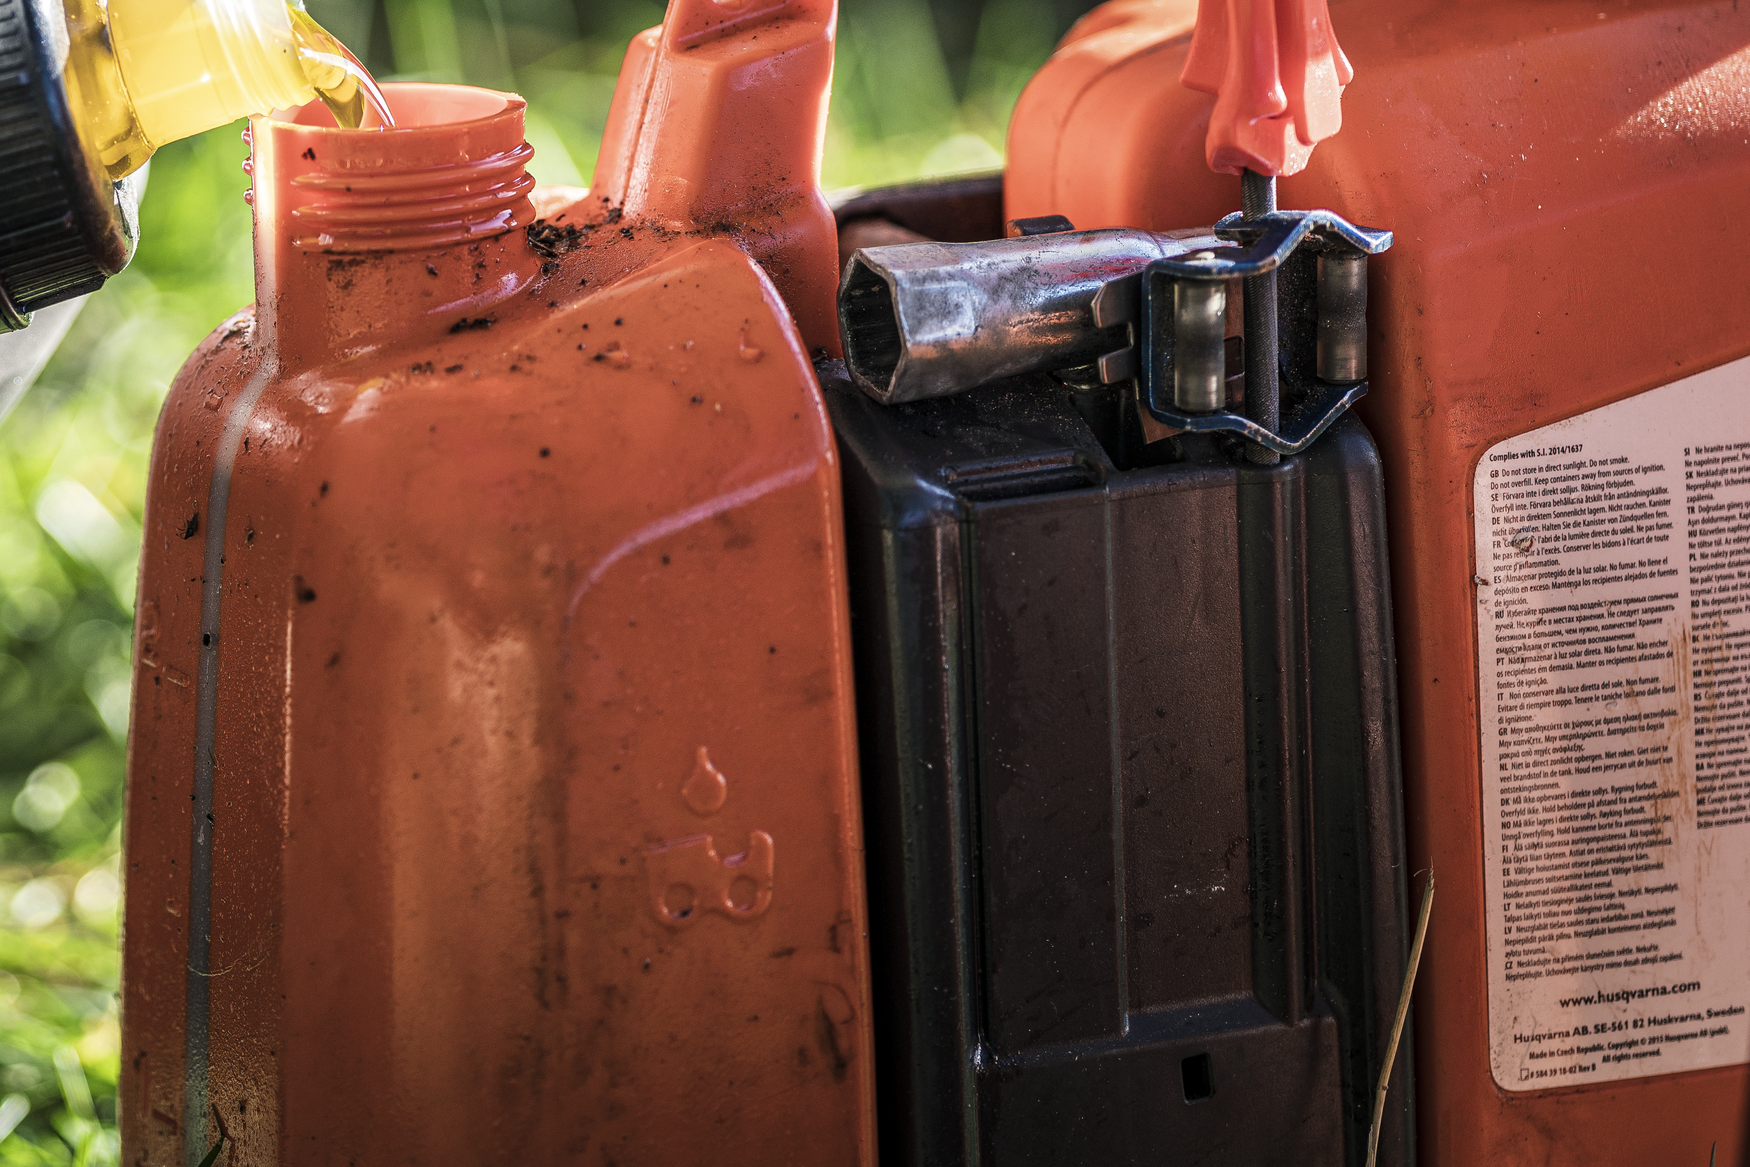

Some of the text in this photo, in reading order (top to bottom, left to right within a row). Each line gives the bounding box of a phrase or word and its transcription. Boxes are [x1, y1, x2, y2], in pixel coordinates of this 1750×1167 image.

[1489, 444, 1582, 461] Complies with S.I. 2014/1637
[1490, 469, 1499, 478] GB
[1502, 469, 1510, 477] Do
[1545, 464, 1561, 472] direct
[1562, 460, 1588, 470] sunlight.
[1589, 459, 1597, 467] Do
[1598, 458, 1608, 466] not
[1609, 456, 1629, 464] smoke.
[1490, 482, 1498, 490] Do
[1511, 478, 1533, 487] overfill.
[1534, 477, 1549, 486] Keep
[1550, 474, 1580, 483] containers
[1581, 472, 1596, 480] away
[1612, 468, 1633, 476] sources
[1490, 493, 1498, 501] SE
[1502, 492, 1524, 500] Förvara
[1541, 487, 1558, 496] direkt
[1581, 483, 1604, 491] Rökning
[1606, 479, 1634, 489] förbjuden.
[1529, 501, 1551, 509] Förvara
[1603, 492, 1615, 500] från
[1492, 516, 1500, 525] DE
[1504, 515, 1518, 523] Nicht
[1526, 513, 1552, 521] direktem
[1553, 508, 1586, 518] Sonnenlicht
[1587, 507, 1606, 516] lagern.
[1608, 503, 1622, 512] Nicht
[1624, 501, 1647, 510] rauchen.
[1648, 499, 1670, 507] Kanister
[1492, 527, 1506, 536] nicht
[1542, 523, 1561, 531] Halten
[1562, 521, 1571, 529] Sie
[1572, 520, 1581, 528] die
[1582, 518, 1606, 526] Kanister
[1619, 512, 1654, 522] Zündquellen
[1655, 510, 1668, 518] fern.
[1492, 540, 1501, 548] FR
[1568, 531, 1589, 540] lumière
[1590, 529, 1610, 538] directe
[1610, 527, 1618, 535] du
[1619, 525, 1635, 534] soleil.
[1636, 524, 1644, 532] Ne
[1645, 524, 1654, 533] pas
[1502, 553, 1512, 561] pas
[1541, 546, 1561, 555] l'excès.
[1562, 544, 1591, 552] Conserver
[1592, 541, 1600, 549] les
[1601, 540, 1621, 548] bidons
[1627, 537, 1644, 545] l'écart
[1645, 535, 1653, 543] de
[1654, 534, 1669, 542] toute
[1538, 569, 1566, 580] protegido
[1567, 567, 1575, 576] de
[1582, 566, 1591, 574] luz
[1593, 564, 1608, 573] solar.
[1609, 563, 1617, 571] No
[1618, 562, 1636, 570] fumar.
[1647, 558, 1661, 566] llene
[1494, 586, 1519, 596] depósito
[1582, 578, 1591, 586] los
[1592, 575, 1623, 585] recipientes
[1624, 572, 1647, 581] alejados
[1648, 570, 1656, 578] de
[1657, 569, 1678, 577] fuentes
[1494, 597, 1528, 608] de ignición.
[1514, 1031, 1570, 1043] Husqvarna
